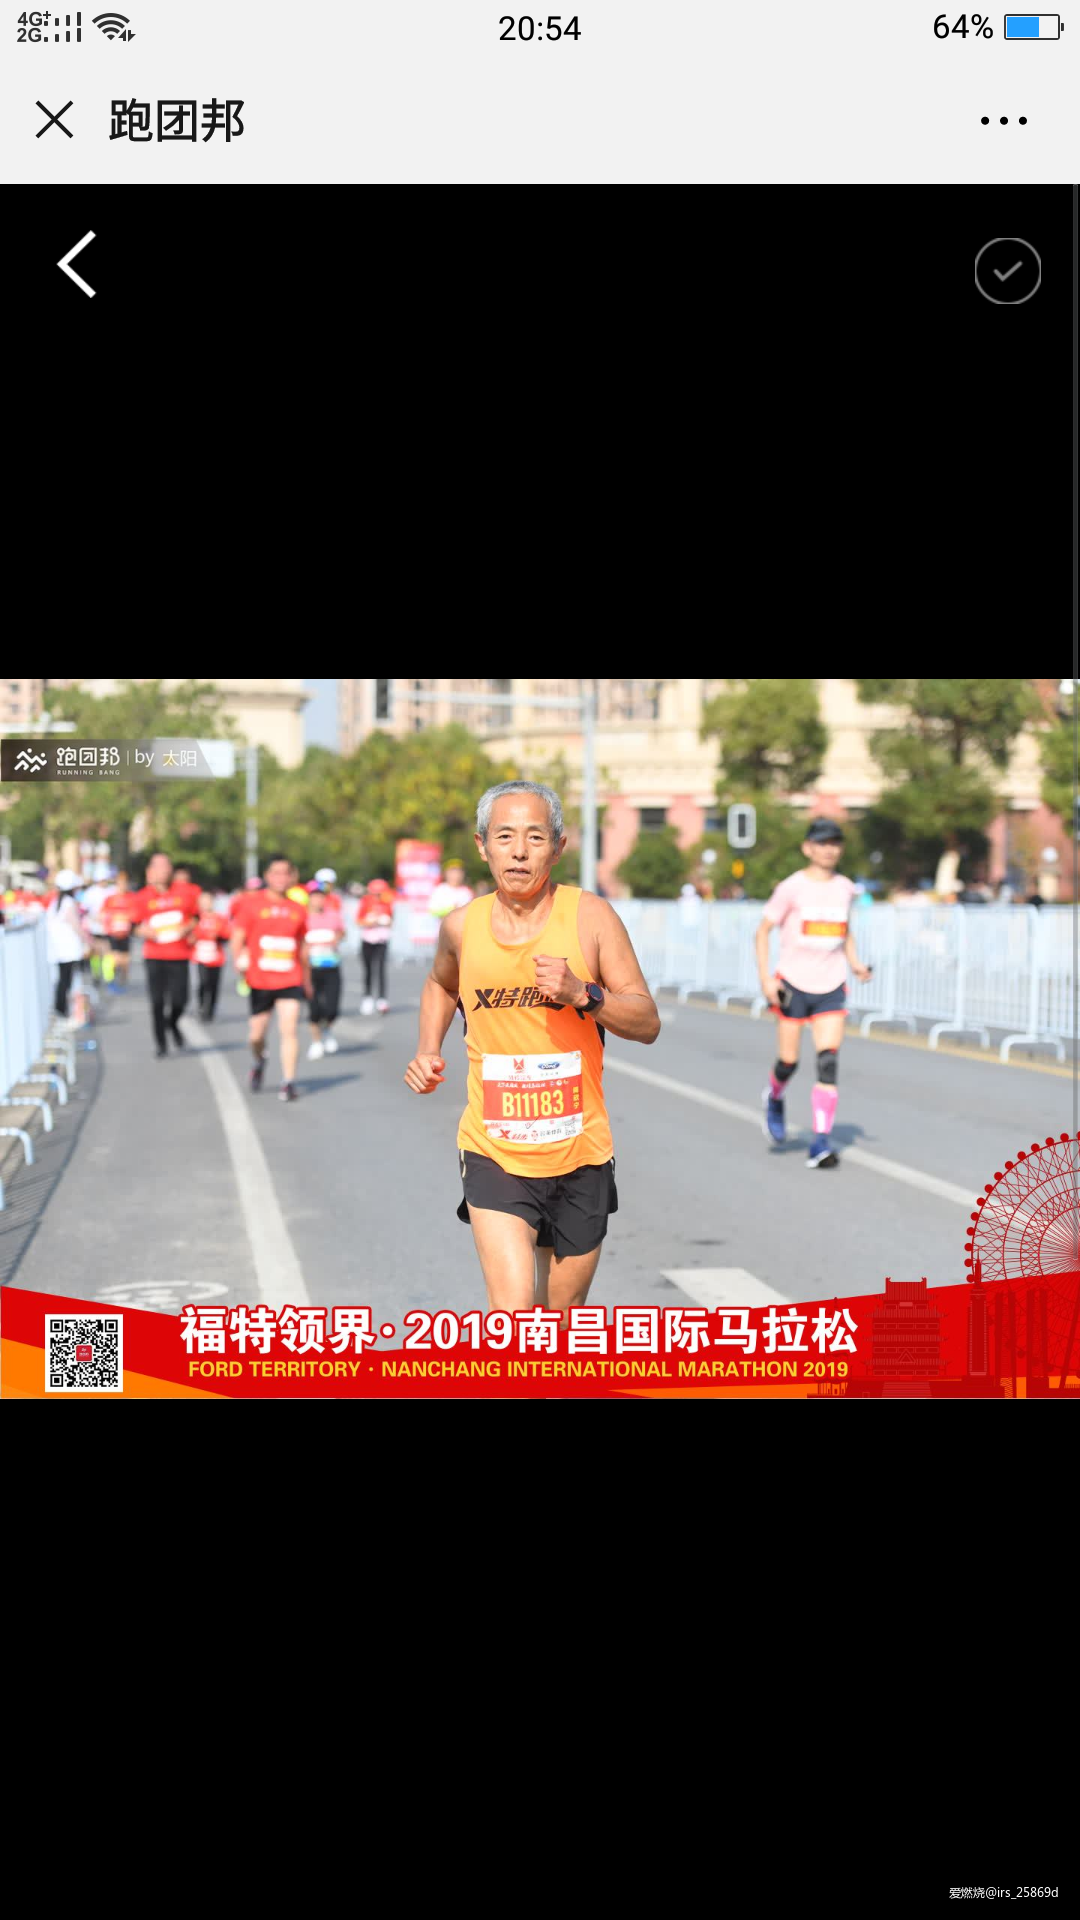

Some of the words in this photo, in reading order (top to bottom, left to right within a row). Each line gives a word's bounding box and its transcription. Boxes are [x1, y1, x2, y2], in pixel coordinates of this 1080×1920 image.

[499, 15, 581, 41] 20:54
[933, 13, 994, 40] 64%
[109, 98, 244, 142] 跑团邦
[502, 1089, 565, 1118] B11183
